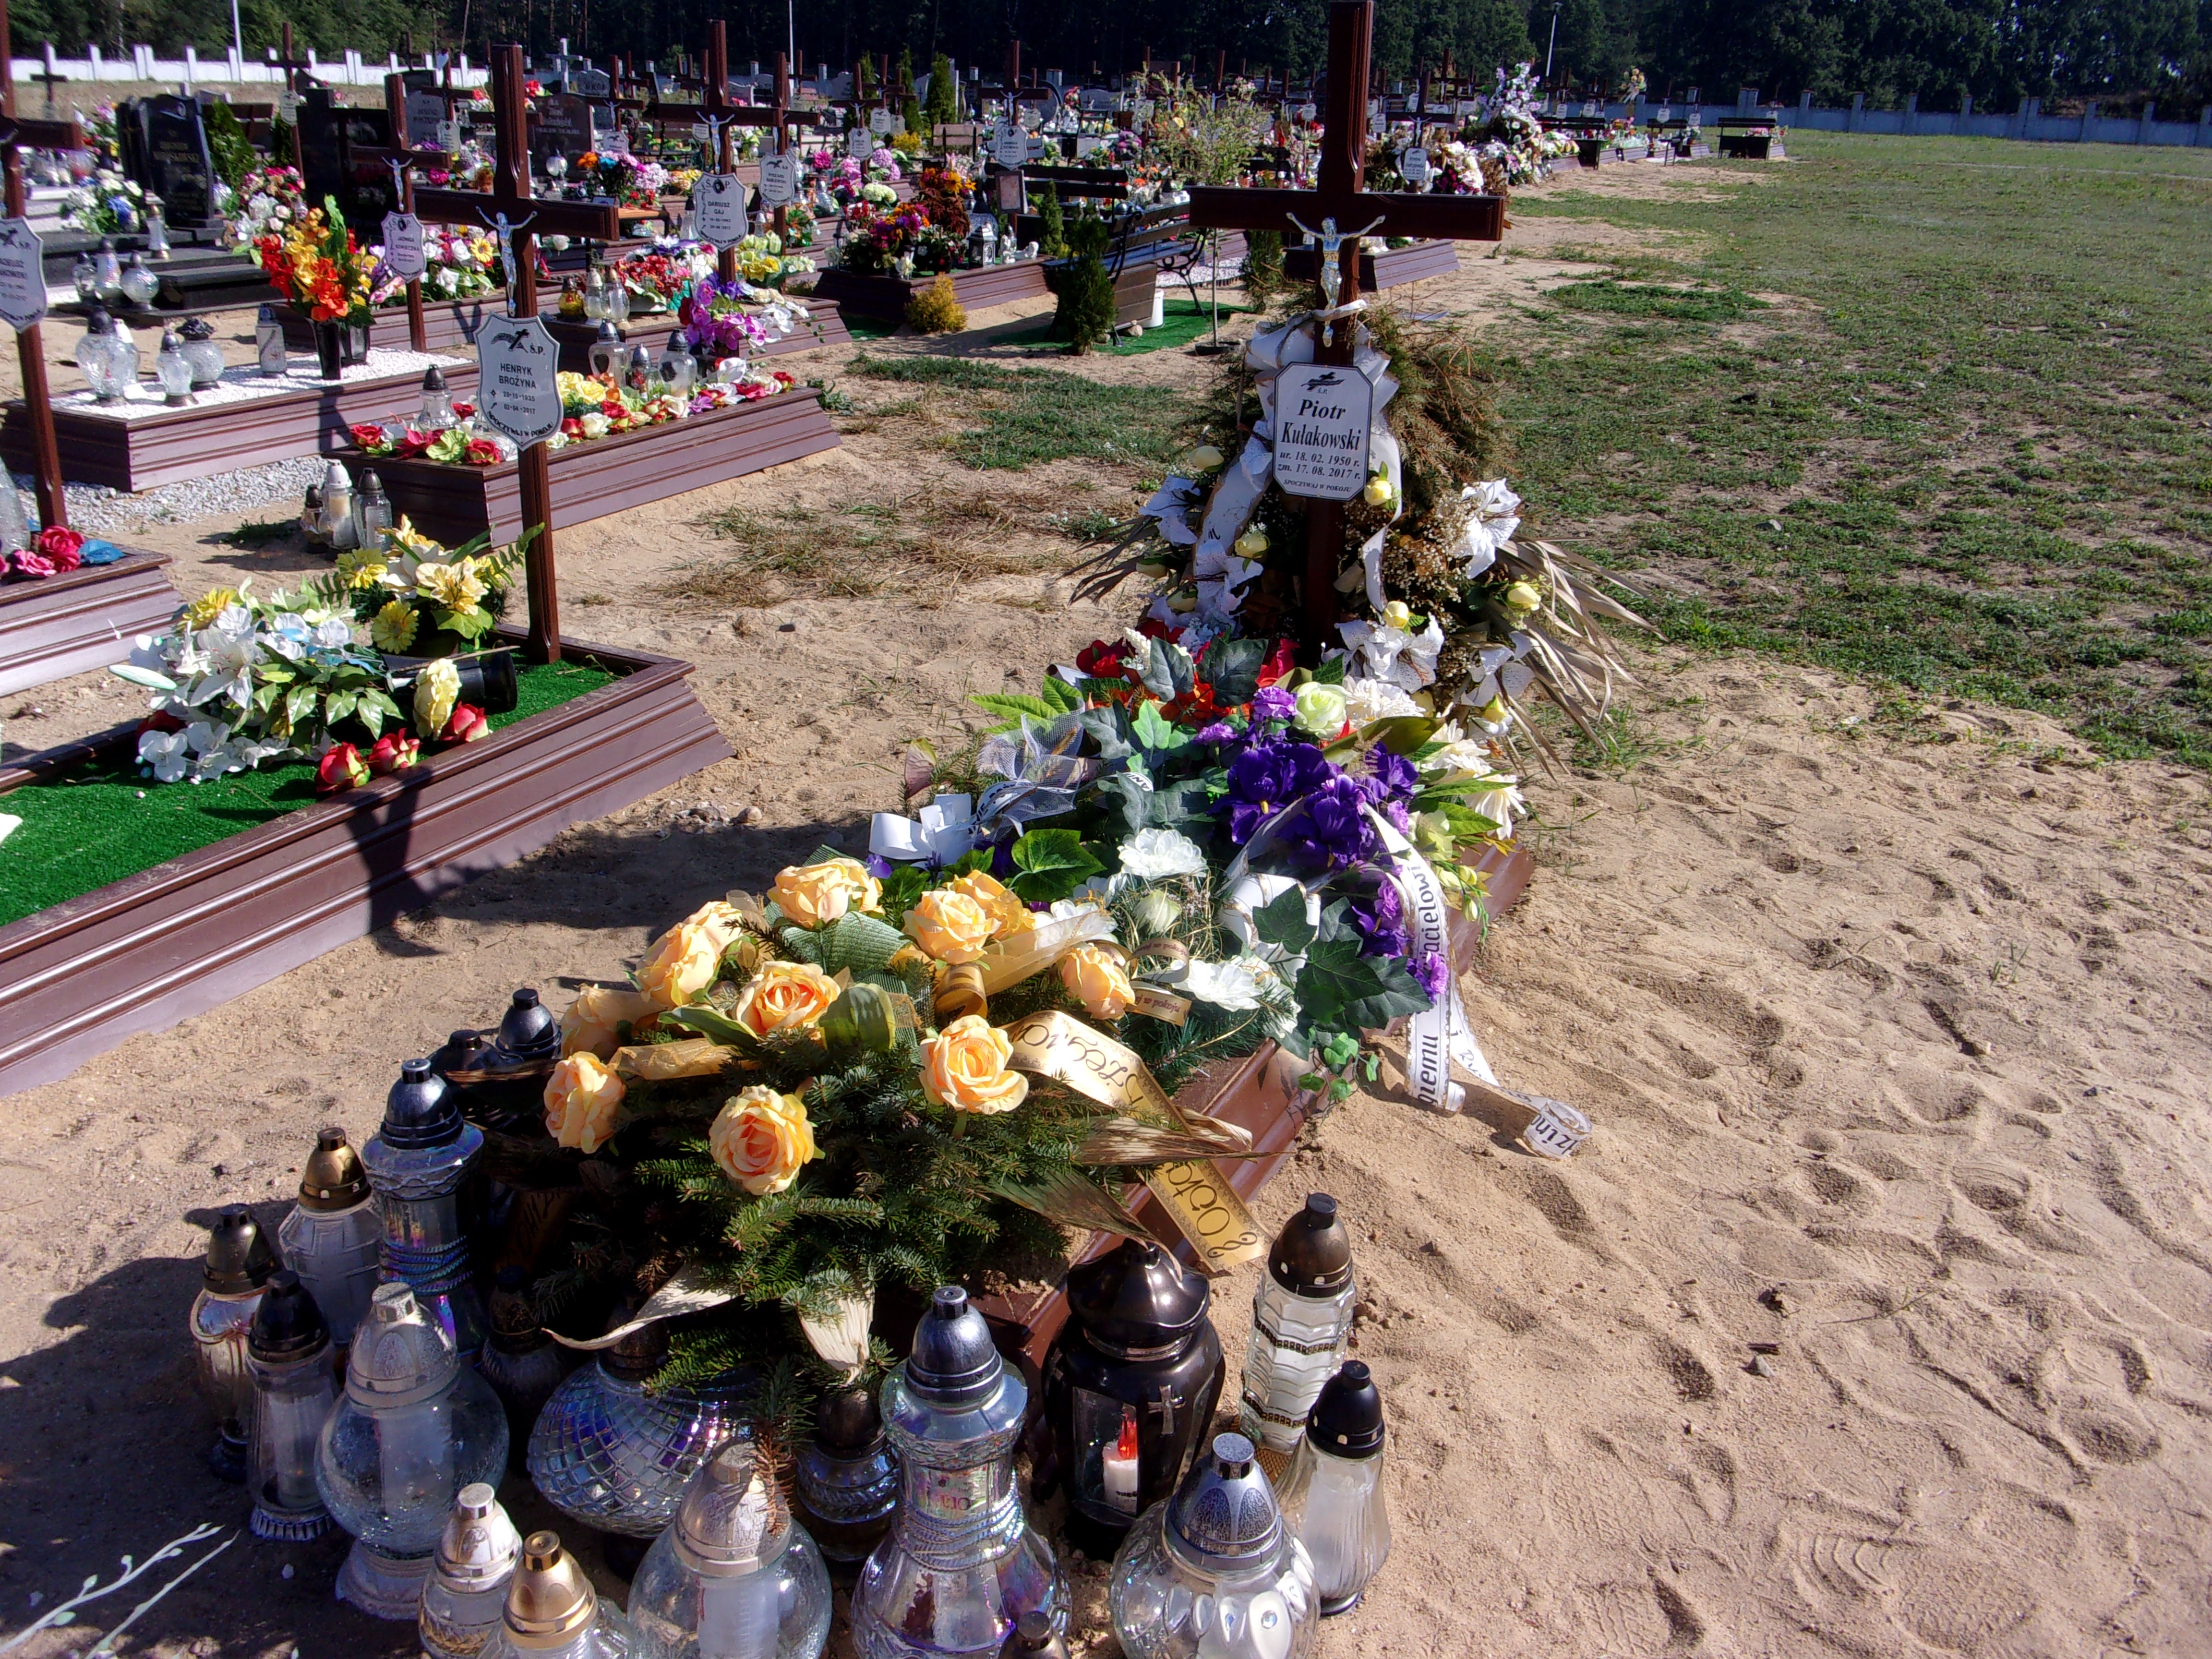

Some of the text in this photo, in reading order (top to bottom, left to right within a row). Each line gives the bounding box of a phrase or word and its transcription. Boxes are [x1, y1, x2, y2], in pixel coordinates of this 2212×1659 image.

[500, 363, 532, 376] HENRYK
[499, 375, 537, 389] BROŻYNA
[1298, 399, 1346, 420] Piotr
[1281, 421, 1361, 450] Kułakowski
[1295, 451, 1307, 461] 18.
[1311, 454, 1324, 463] 02.
[1328, 455, 1351, 466] 1950
[1296, 464, 1308, 474] 17.
[1311, 466, 1324, 476] 08.
[1329, 468, 1352, 479] 2017
[1283, 479, 1319, 489] SPOCZYWAJ
[1153, 1000, 1180, 1013] pokoju
[1418, 1034, 1439, 1104] giemu
